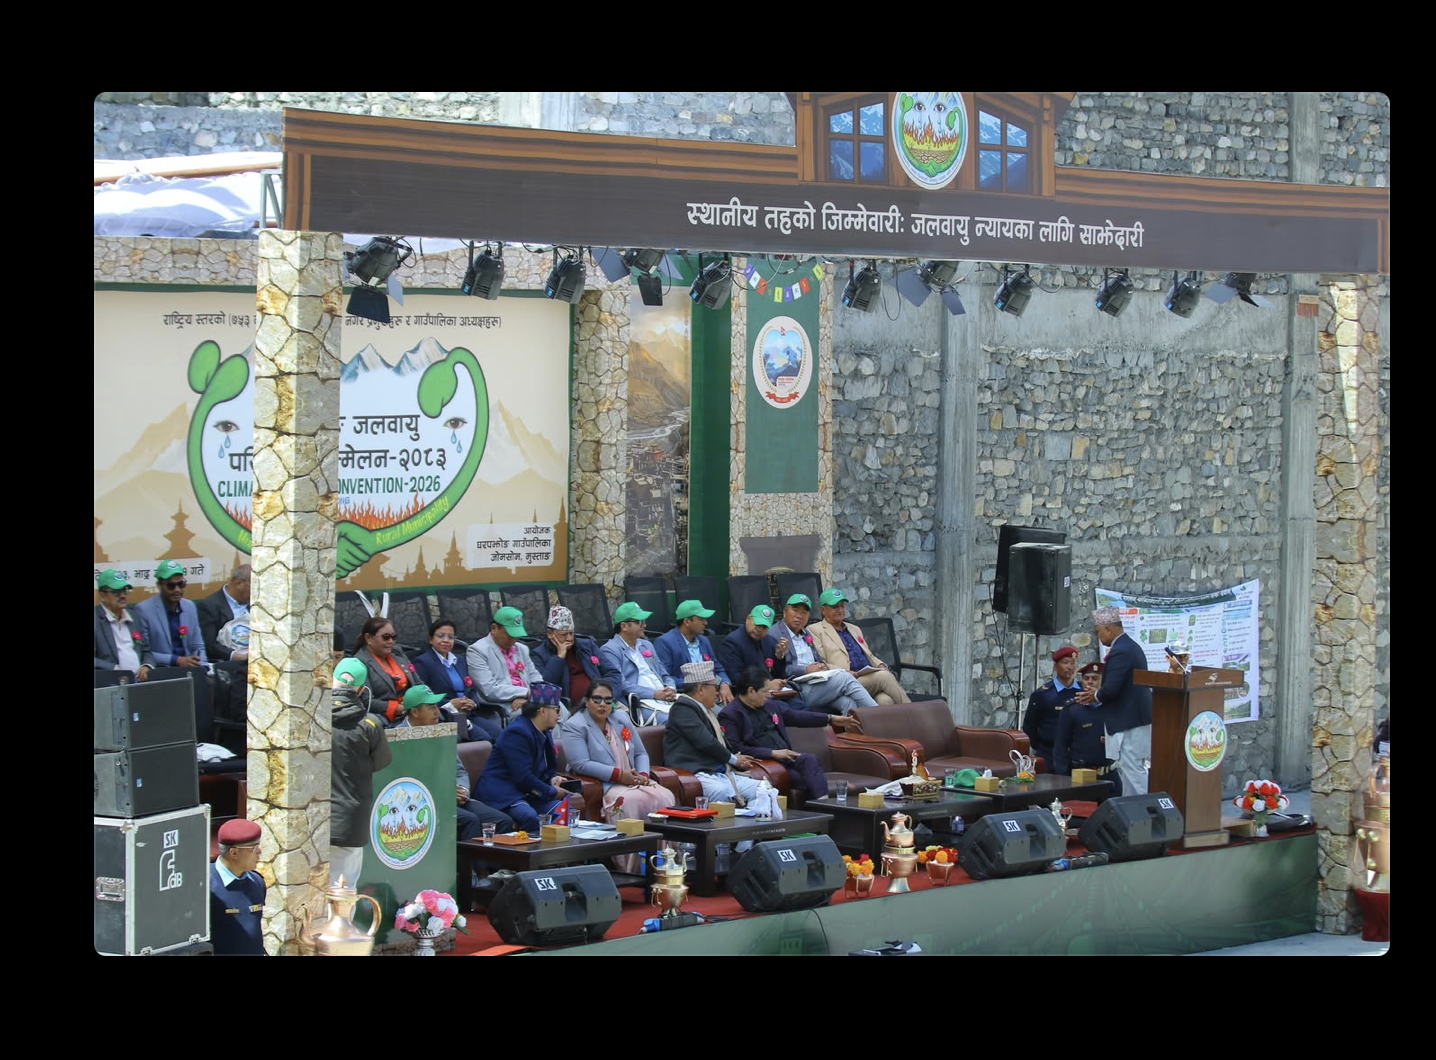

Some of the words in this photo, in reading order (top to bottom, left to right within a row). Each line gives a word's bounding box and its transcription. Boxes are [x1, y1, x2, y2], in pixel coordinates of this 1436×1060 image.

[686, 197, 759, 228] स्थानीय
[764, 201, 816, 235] तहको
[910, 213, 971, 246] जलवायु
[974, 216, 1035, 240] न्यायका
[1039, 215, 1075, 243] लागि
[1079, 219, 1145, 250] साझेदारी
[195, 310, 226, 325] स्तरको
[413, 312, 457, 327] गाउँपालिका
[353, 414, 420, 442] जलवायु
[339, 443, 447, 472] मेलन-२०८३
[375, 527, 401, 545] Rural
[400, 496, 450, 536] Municipality
[524, 525, 551, 535] आयोजक
[512, 537, 551, 548] गाउँपालिका
[525, 552, 551, 564] मुस्ताङ
[190, 564, 205, 576] गते
[1005, 821, 1018, 831] SK
[165, 831, 177, 847] SK
[780, 851, 794, 861] SK
[537, 878, 554, 889] SK
